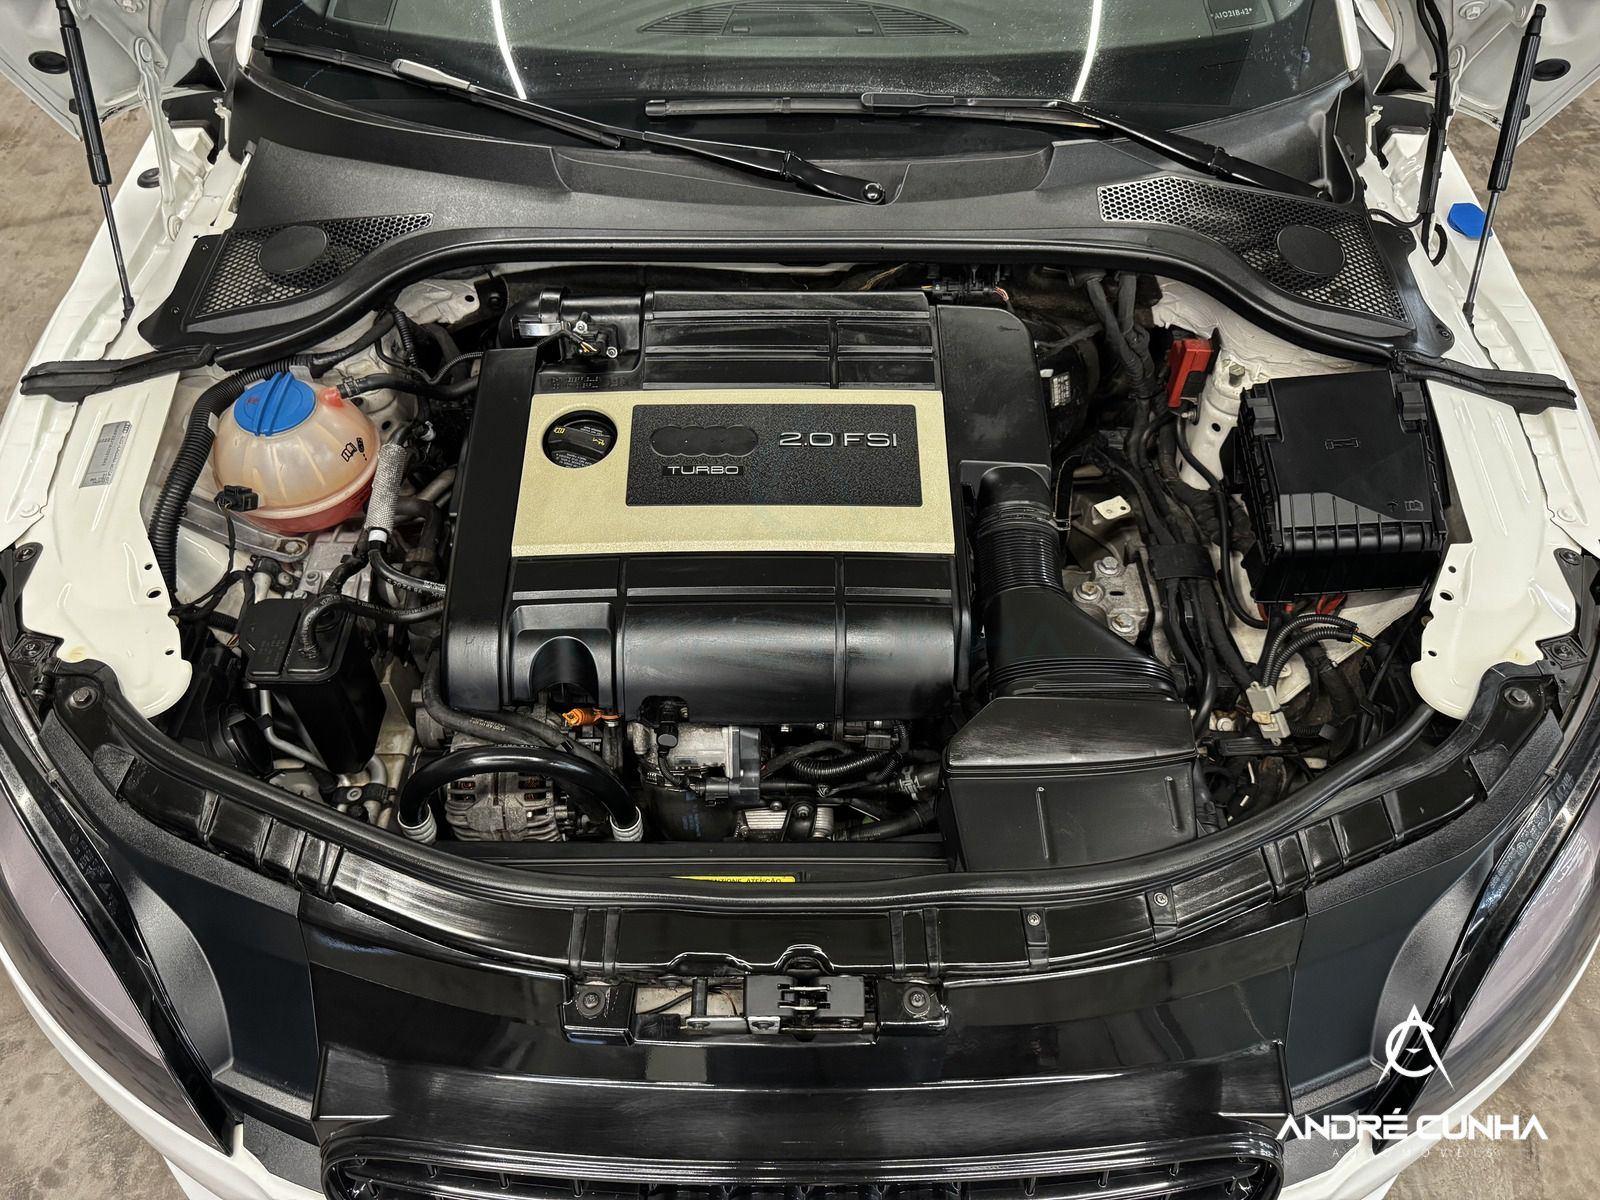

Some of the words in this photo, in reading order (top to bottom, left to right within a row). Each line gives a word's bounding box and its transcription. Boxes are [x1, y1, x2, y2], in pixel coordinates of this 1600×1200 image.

[778, 432, 834, 447] 2.0
[843, 432, 898, 447] FSI
[667, 465, 740, 475] TURBO
